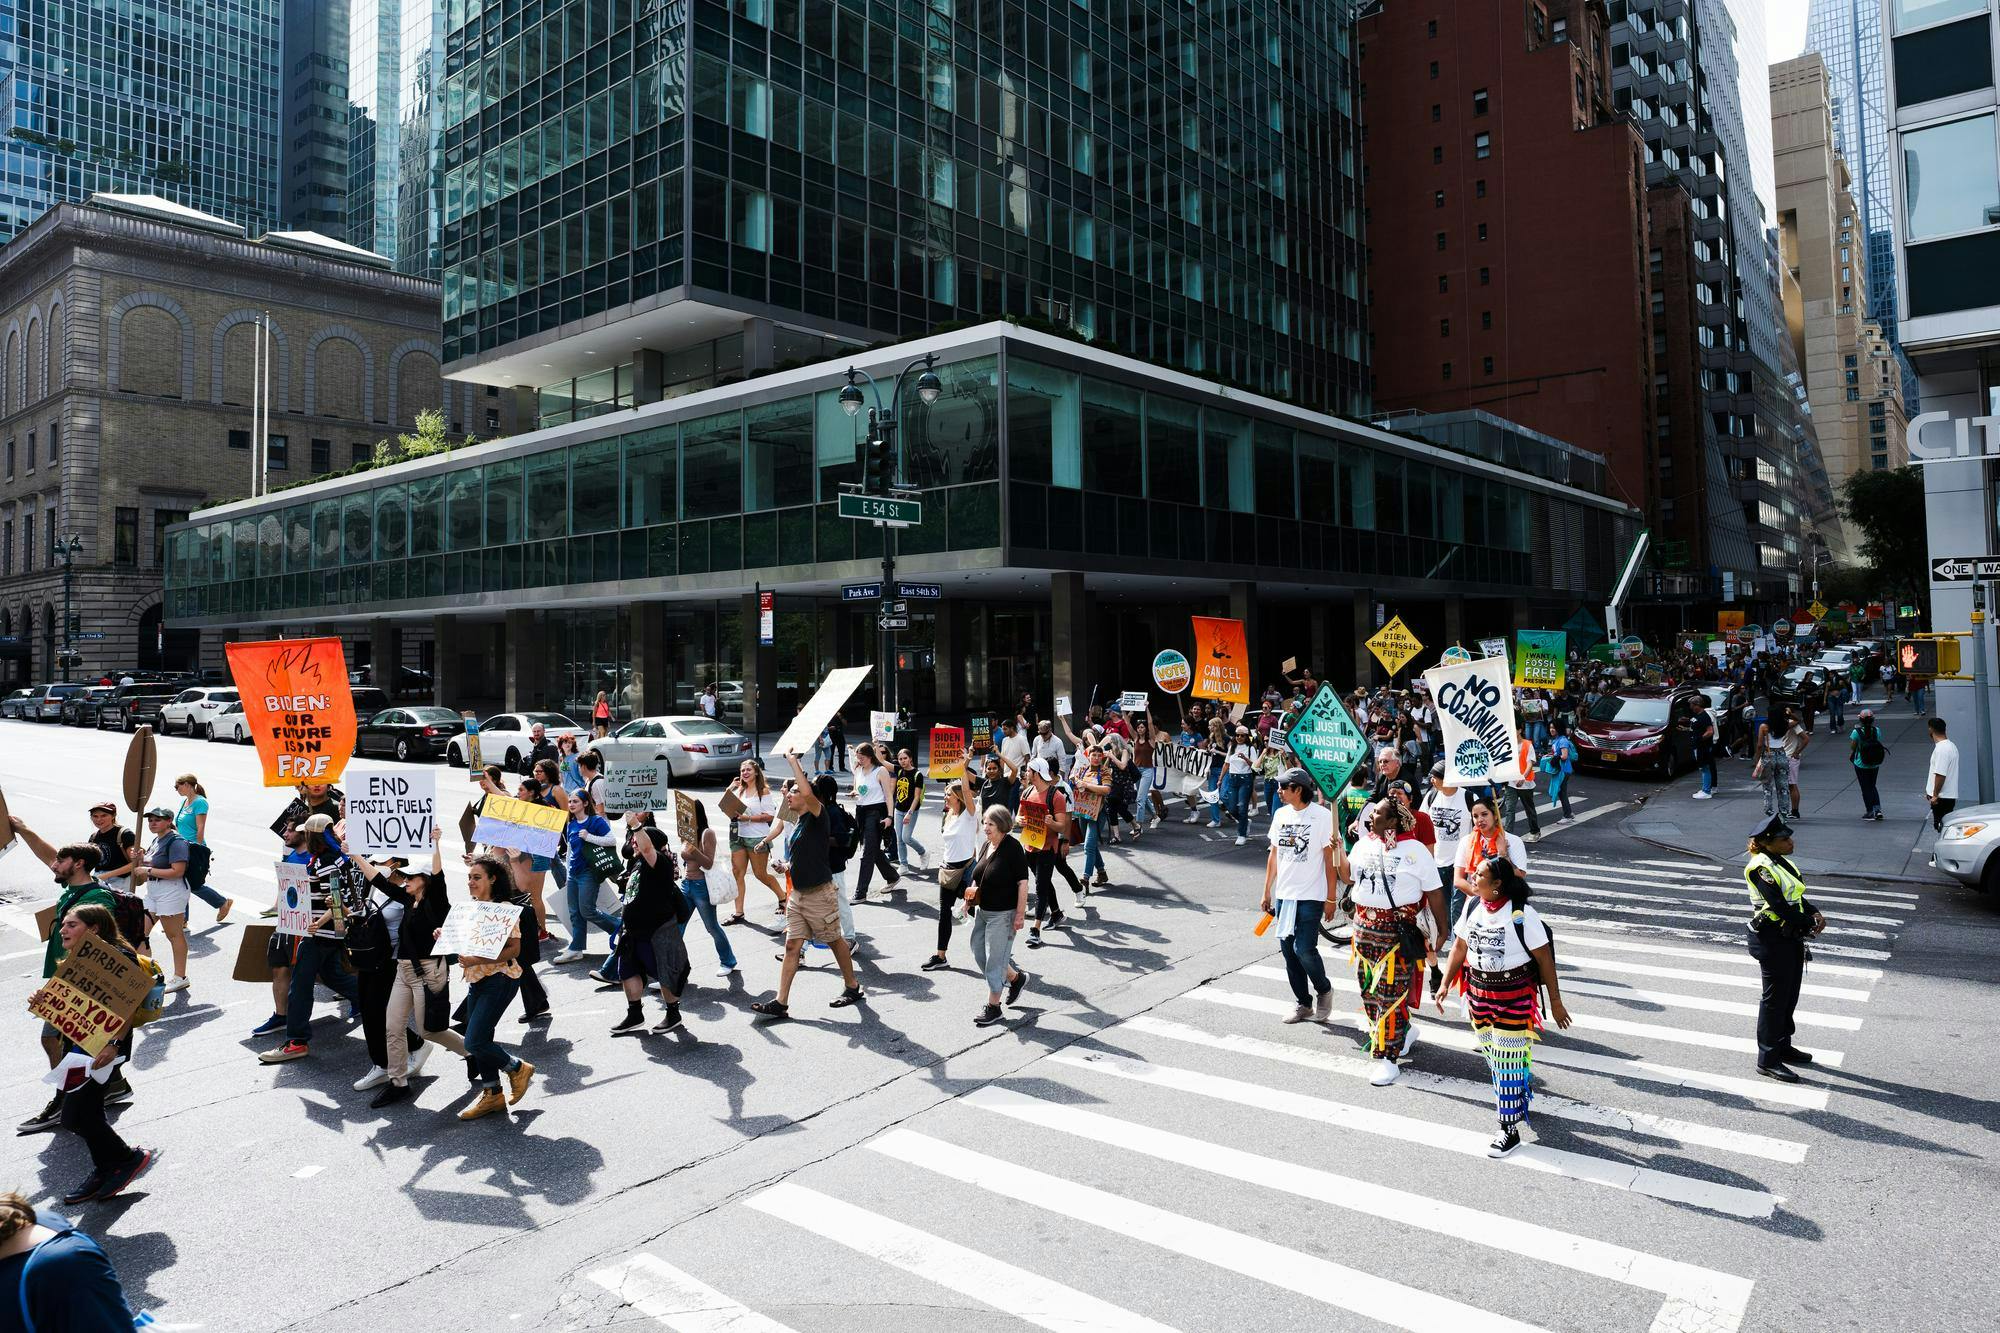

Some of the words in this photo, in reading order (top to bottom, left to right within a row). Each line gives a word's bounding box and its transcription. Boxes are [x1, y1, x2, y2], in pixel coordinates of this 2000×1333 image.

[863, 501, 869, 514] E
[873, 502, 885, 516] 54
[889, 505, 899, 517] St
[1943, 564, 1969, 574] ONE
[848, 587, 862, 597] Park
[863, 587, 874, 596] Ave
[900, 587, 915, 595] East
[916, 587, 930, 595] 54th
[931, 587, 938, 596] St
[1525, 659, 1556, 668] FOSSIL
[1156, 663, 1187, 679] VOTE
[1204, 664, 1241, 679] CANCEL
[1525, 667, 1557, 680] FREE
[1202, 679, 1241, 694] WILLOW
[1464, 674, 1500, 707] NO
[972, 717, 989, 727] BIDEN
[1316, 722, 1339, 732] JUST
[272, 726, 331, 738] FUTURE
[935, 733, 960, 742] BIDEN
[1299, 734, 1357, 750] TRANSITION
[1457, 739, 1486, 755] PROTECT
[1155, 741, 1211, 777] MOVEMENT
[1313, 749, 1346, 762] AHEAD
[1455, 753, 1489, 767] MOTHER
[277, 754, 331, 778] FIRE
[632, 765, 657, 776] running
[1459, 764, 1488, 778] EARTH
[617, 775, 625, 783] of
[629, 774, 657, 783] TIME
[369, 777, 409, 796] END
[624, 789, 652, 799] Energy
[350, 799, 393, 814] FOSSIL
[397, 797, 432, 814] FUELS
[651, 799, 667, 809] NOW
[366, 816, 433, 848] NOW!
[595, 856, 614, 867] SIMPLE
[601, 863, 613, 871] LIFE
[77, 940, 128, 979] BARBIE
[42, 992, 65, 1011] END
[65, 1007, 97, 1035] FOSSIL
[50, 981, 71, 998] IT'S
[72, 995, 84, 1007] IN
[83, 1000, 123, 1033] YOU
[31, 1003, 53, 1020] FUEL
[53, 1015, 89, 1042] NOW
